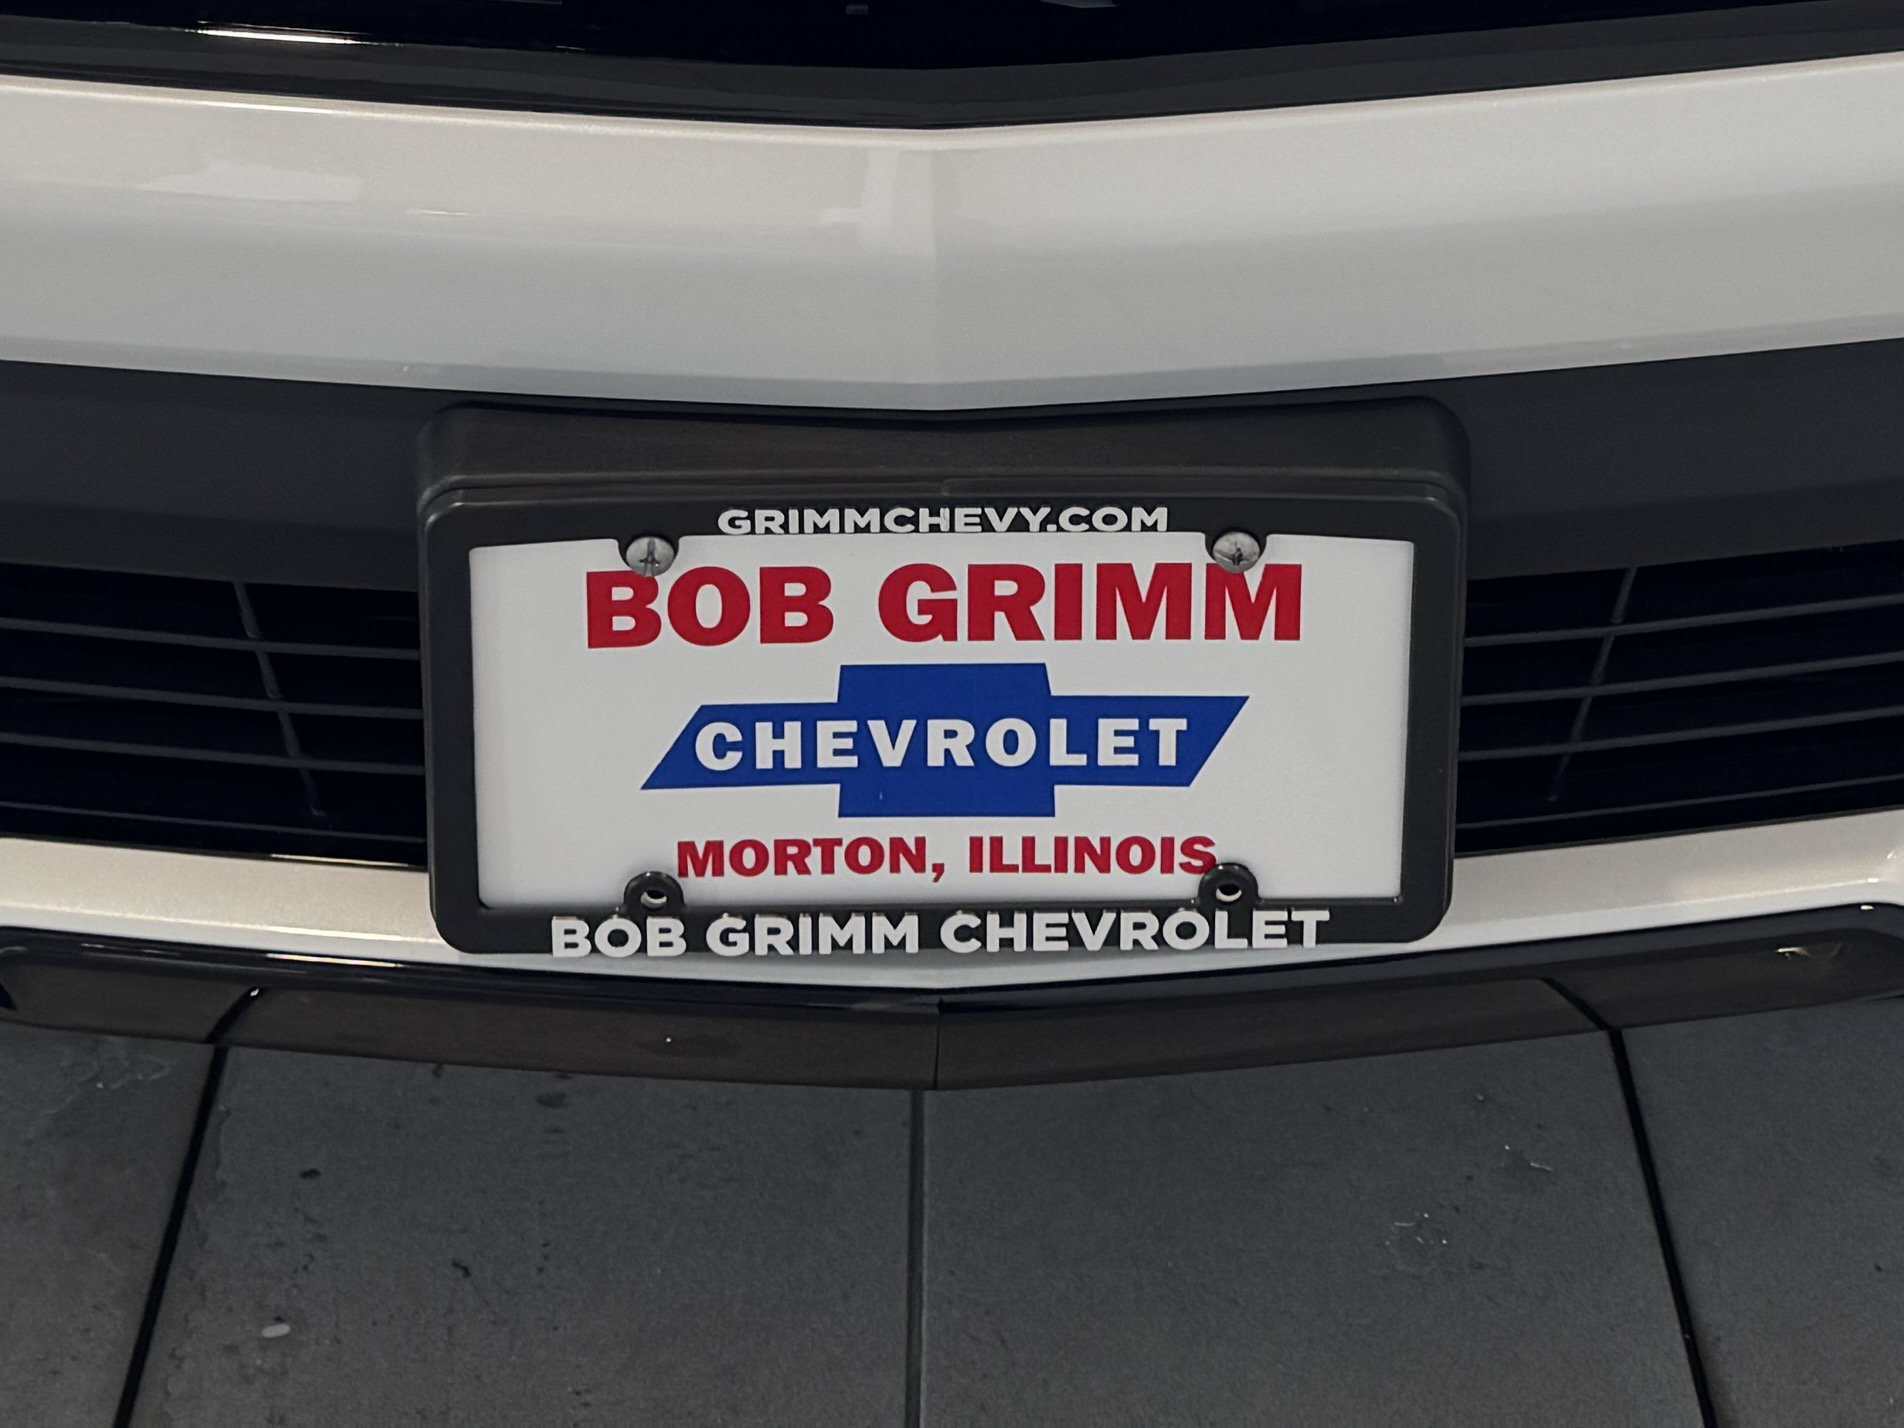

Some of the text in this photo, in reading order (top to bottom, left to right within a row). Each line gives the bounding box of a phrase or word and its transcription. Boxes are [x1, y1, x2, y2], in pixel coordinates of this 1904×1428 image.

[717, 506, 1169, 535] GRIMMCHEVY.COM
[585, 562, 1303, 649] BOB GRIMM
[694, 716, 1189, 773] CHEVROLET
[676, 835, 1217, 883] MORTON, ILLINOIS
[550, 909, 1331, 959] BOB GRIMM CHEVROLET
